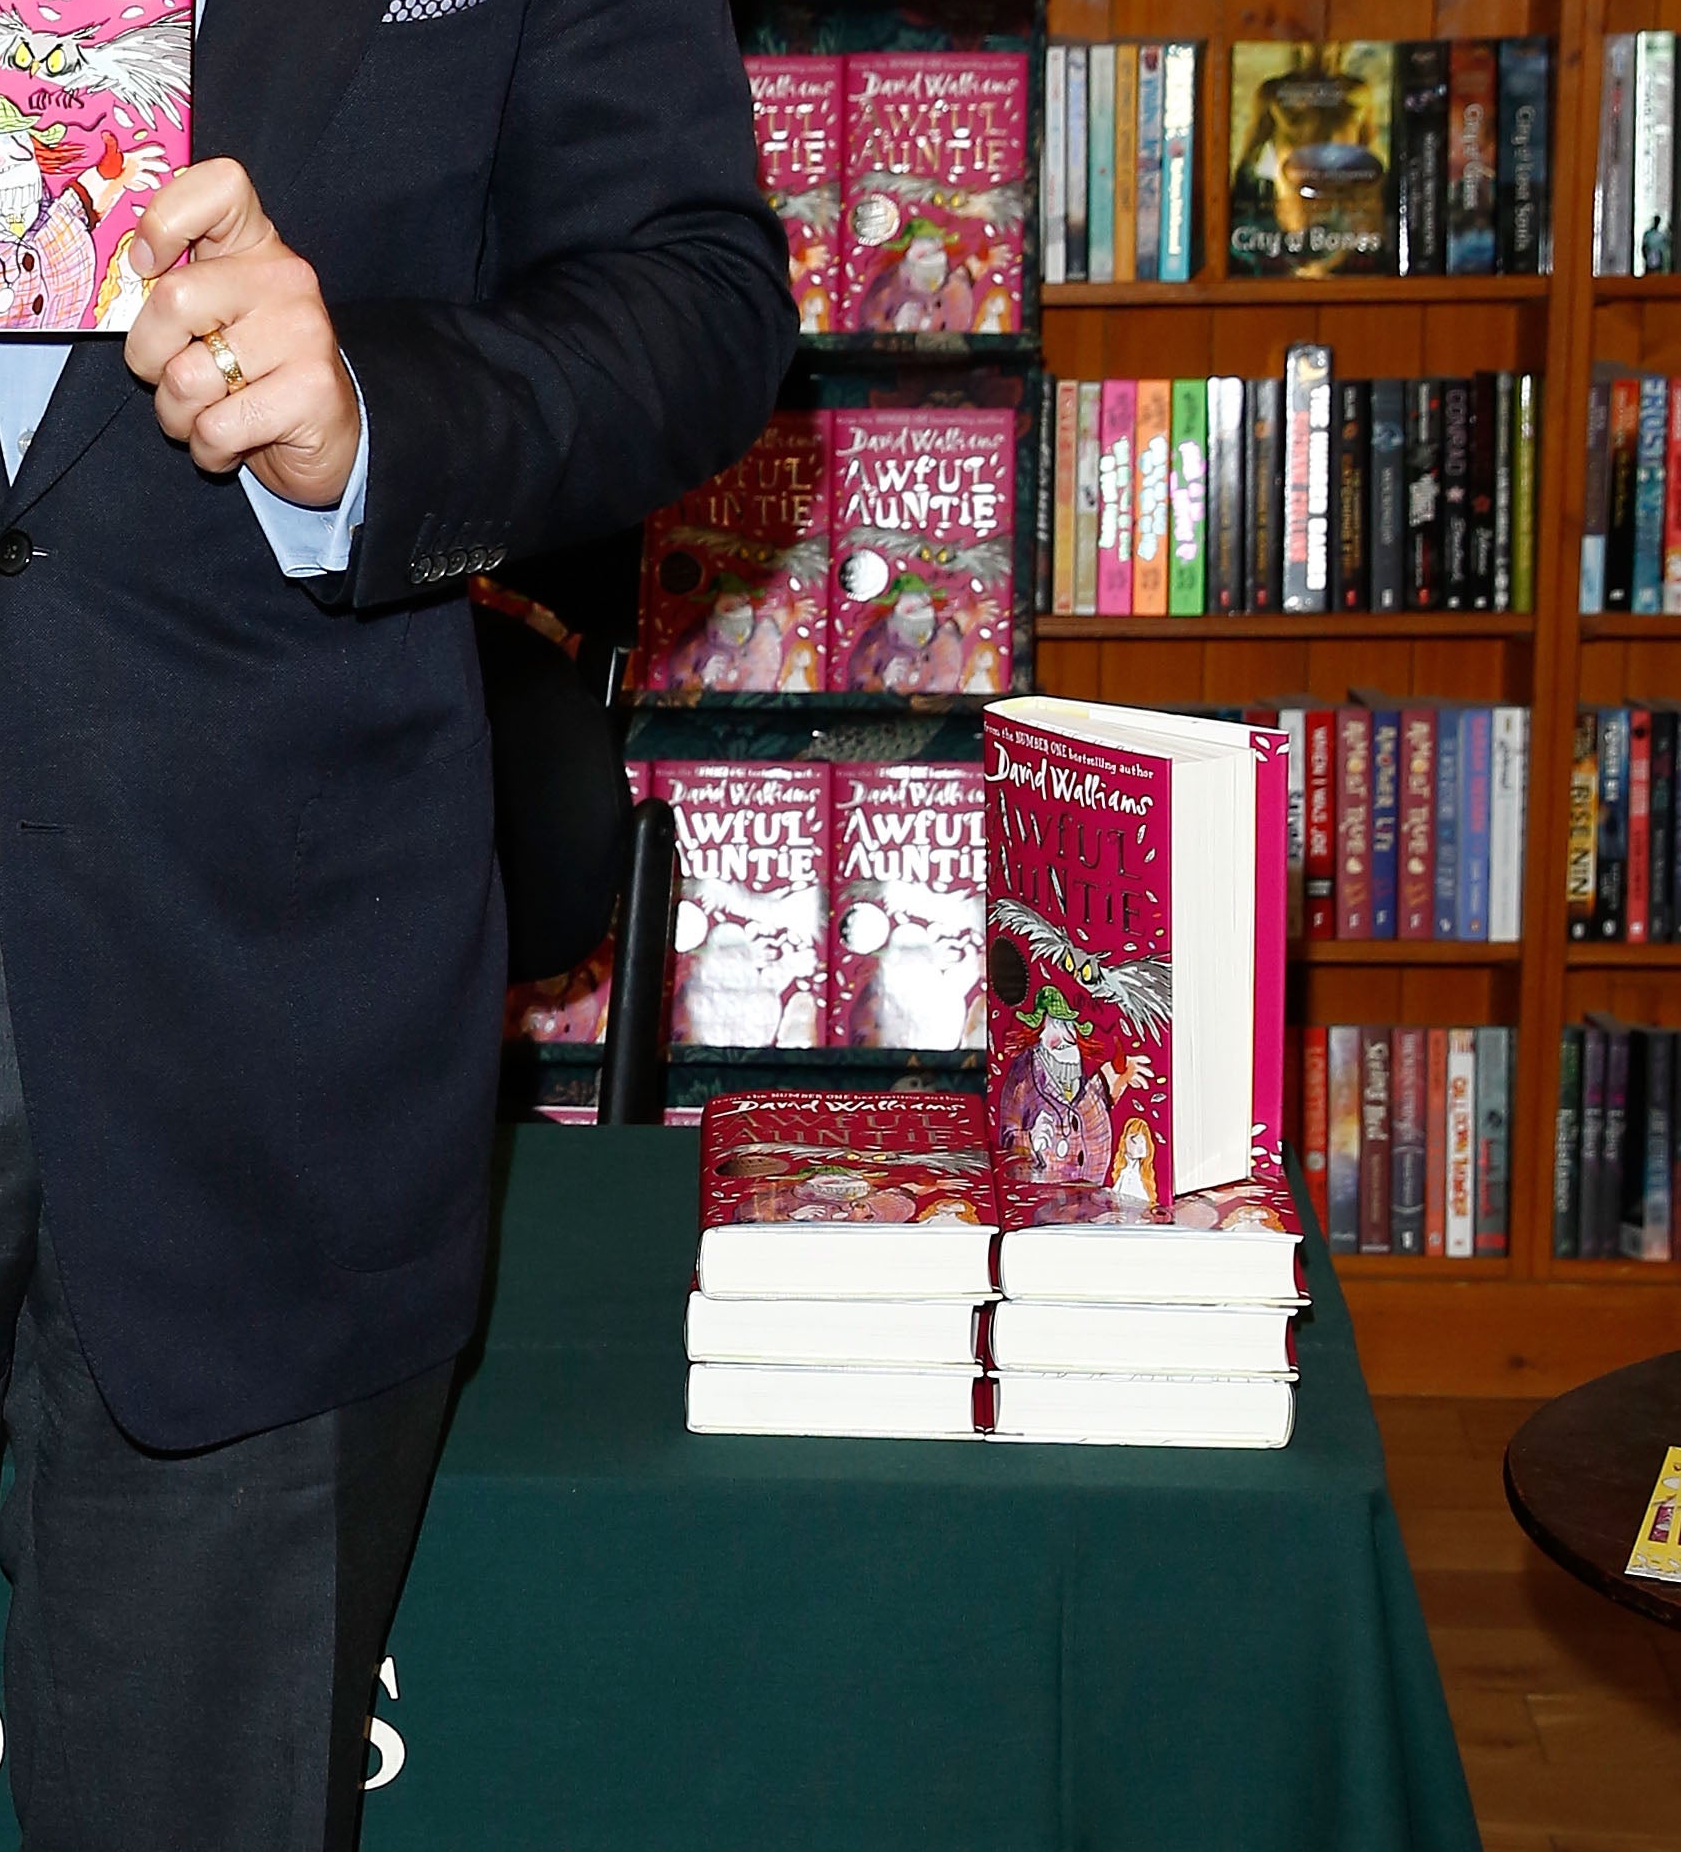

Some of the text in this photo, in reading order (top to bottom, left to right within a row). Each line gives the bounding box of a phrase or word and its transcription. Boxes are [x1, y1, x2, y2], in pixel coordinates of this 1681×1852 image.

[1231, 225, 1281, 258] City
[1309, 225, 1382, 253] Bones
[844, 455, 996, 493] AWFUL
[844, 491, 998, 530] AUNTIE
[1002, 727, 1014, 742] the
[1016, 731, 1049, 755] NUMBER
[1050, 741, 1067, 758] ONE
[1069, 748, 1116, 775] bestselling
[1119, 761, 1154, 779] author
[984, 741, 1153, 816] David Walliams
[711, 1100, 966, 1119] David Walliams
